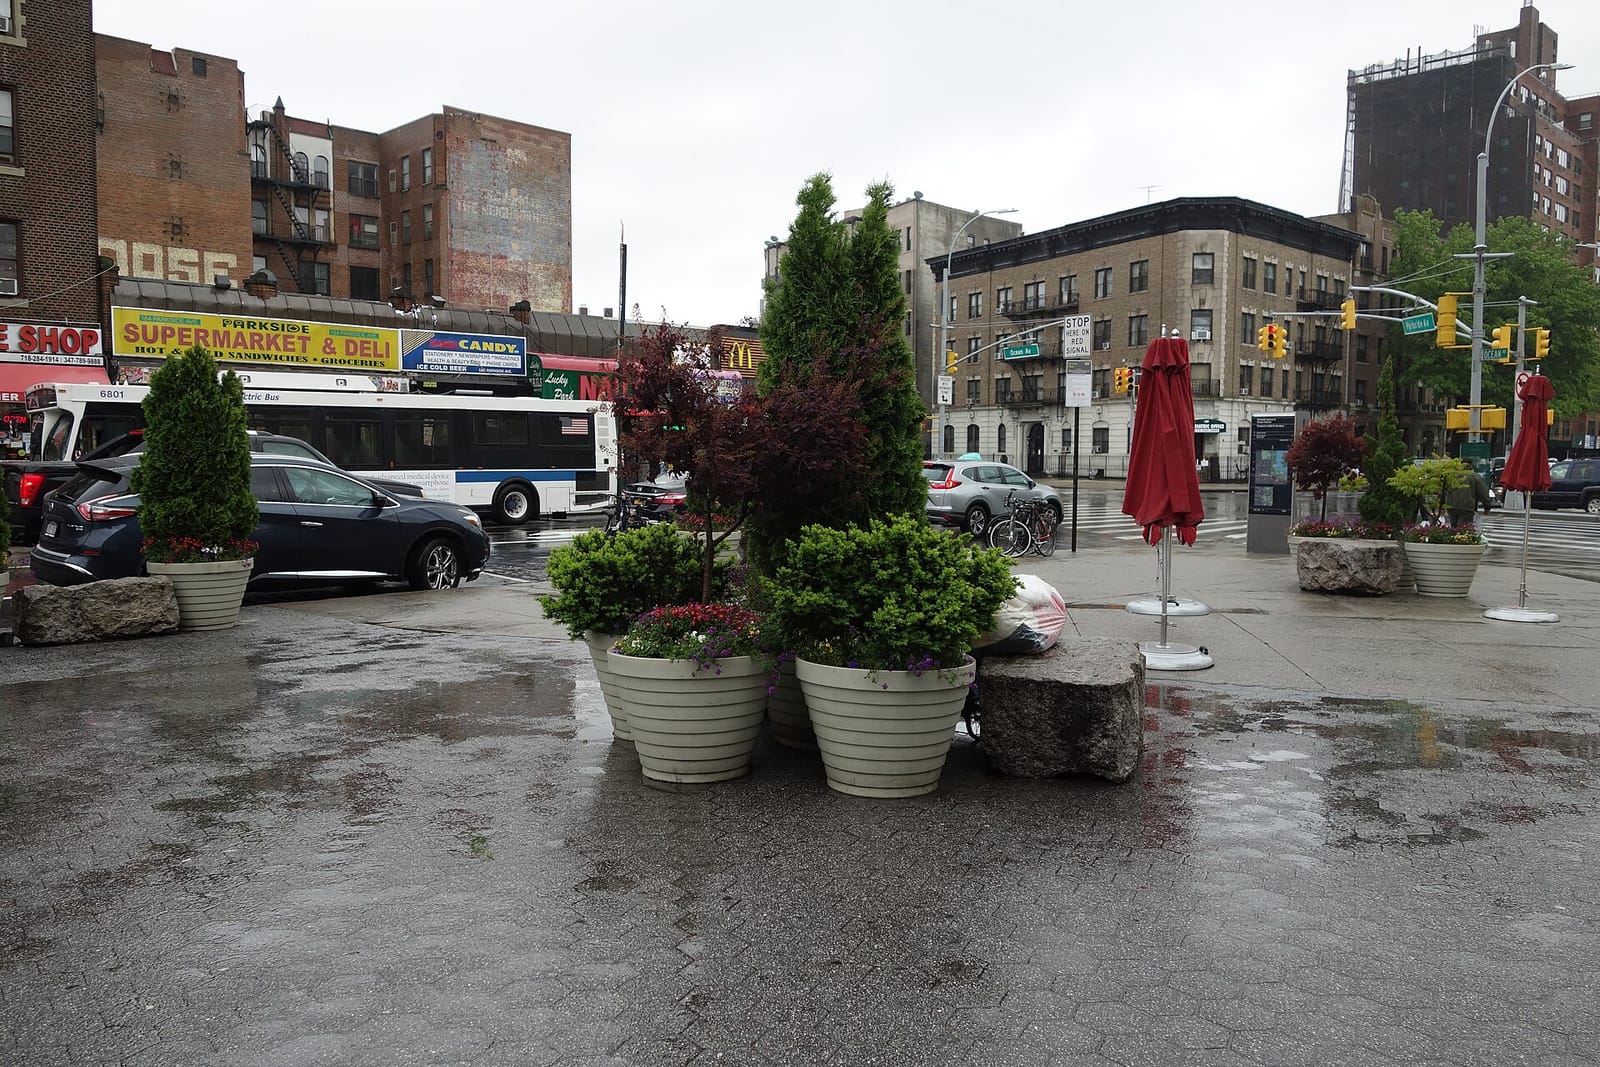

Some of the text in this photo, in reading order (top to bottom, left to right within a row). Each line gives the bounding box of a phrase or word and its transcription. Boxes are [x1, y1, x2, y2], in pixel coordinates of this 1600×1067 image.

[223, 319, 309, 333] PARKSIDE
[1066, 317, 1089, 328] STOP
[1081, 328, 1089, 336] ON
[19, 326, 98, 354] SHOP
[123, 323, 390, 359] SUPERMARKET & DELI
[458, 339, 516, 353] CANDY
[1066, 346, 1088, 354] SIGNAL
[135, 346, 165, 354] HOT
[228, 351, 308, 363] SANDWICHES
[321, 357, 385, 367] GROCERIES
[1484, 350, 1501, 359] OCEAN
[545, 371, 568, 388] Lucky
[0, 393, 19, 401] ER
[100, 390, 124, 398] 6801
[243, 393, 279, 401] ctric Bus
